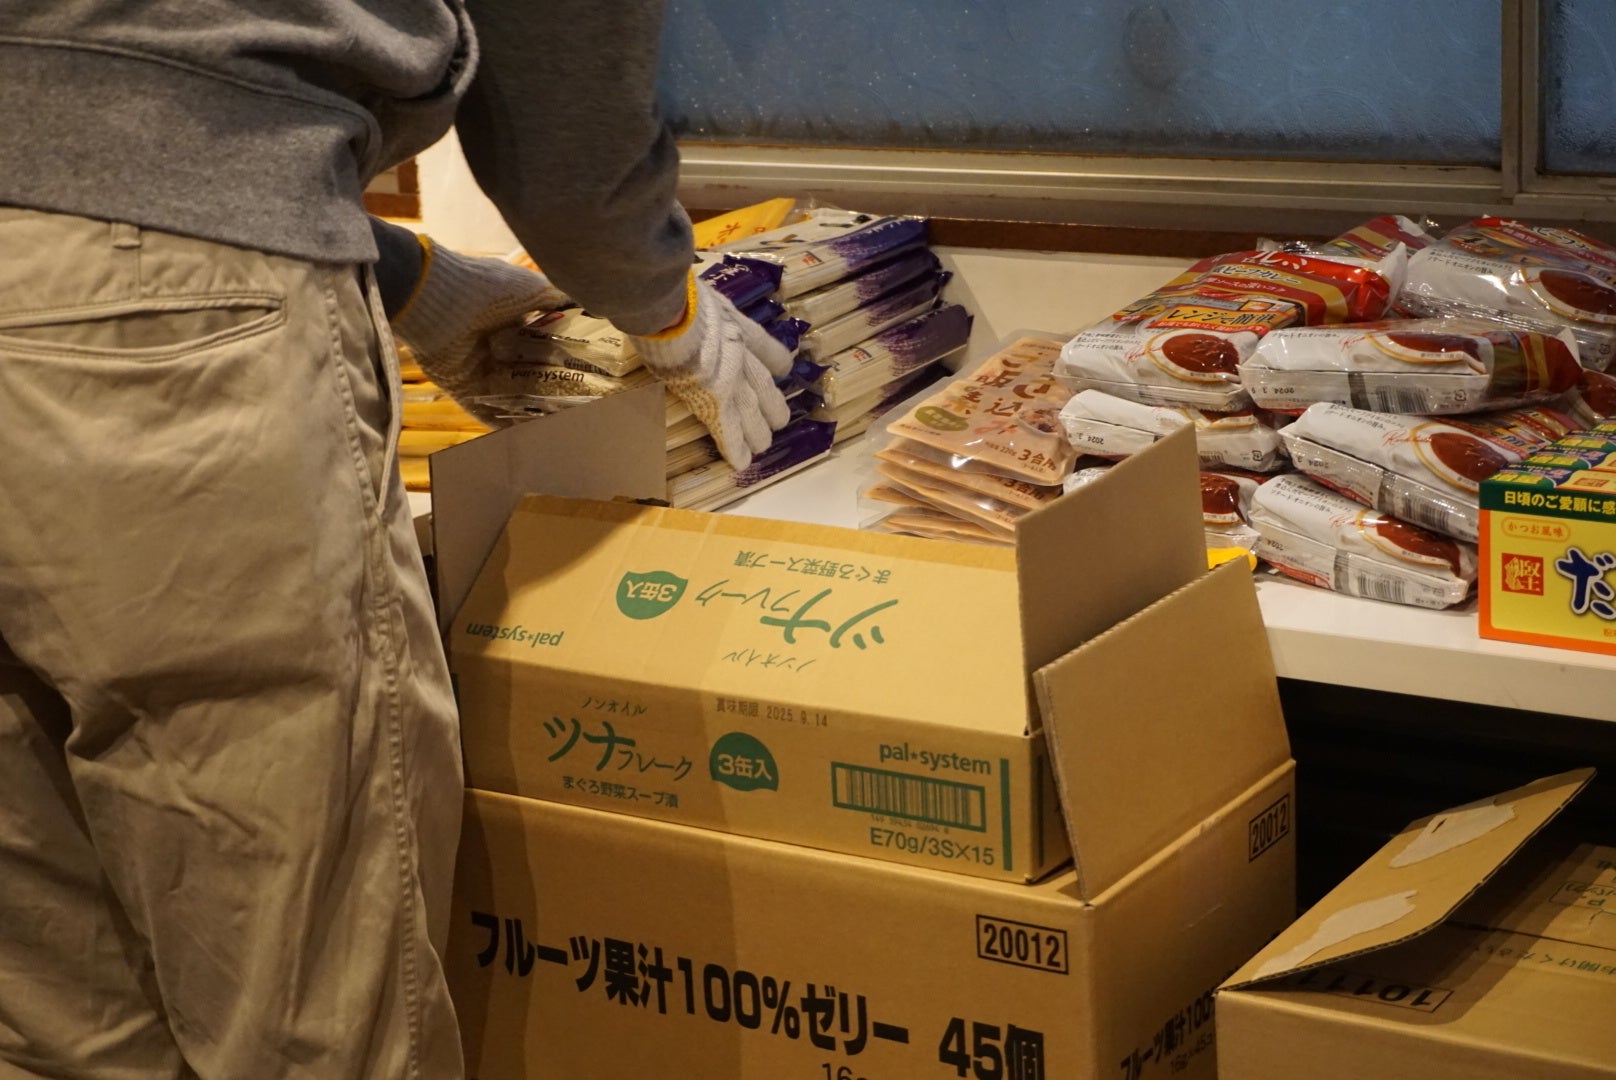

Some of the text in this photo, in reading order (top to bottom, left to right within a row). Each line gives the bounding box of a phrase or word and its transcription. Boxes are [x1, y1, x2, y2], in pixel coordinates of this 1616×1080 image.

[734, 550, 892, 585] まぐろ野菜スープ漬
[625, 579, 679, 603] 3缶入
[721, 650, 818, 673] ノンオイル
[580, 697, 648, 717] ノンオイル
[717, 753, 774, 782] 3缶入
[562, 774, 680, 809] まぐろ野菜スープ漬
[1251, 803, 1288, 856] 20012
[982, 921, 1063, 968] 20012
[470, 910, 910, 1056] フルーツ果汁100%ゼリー
